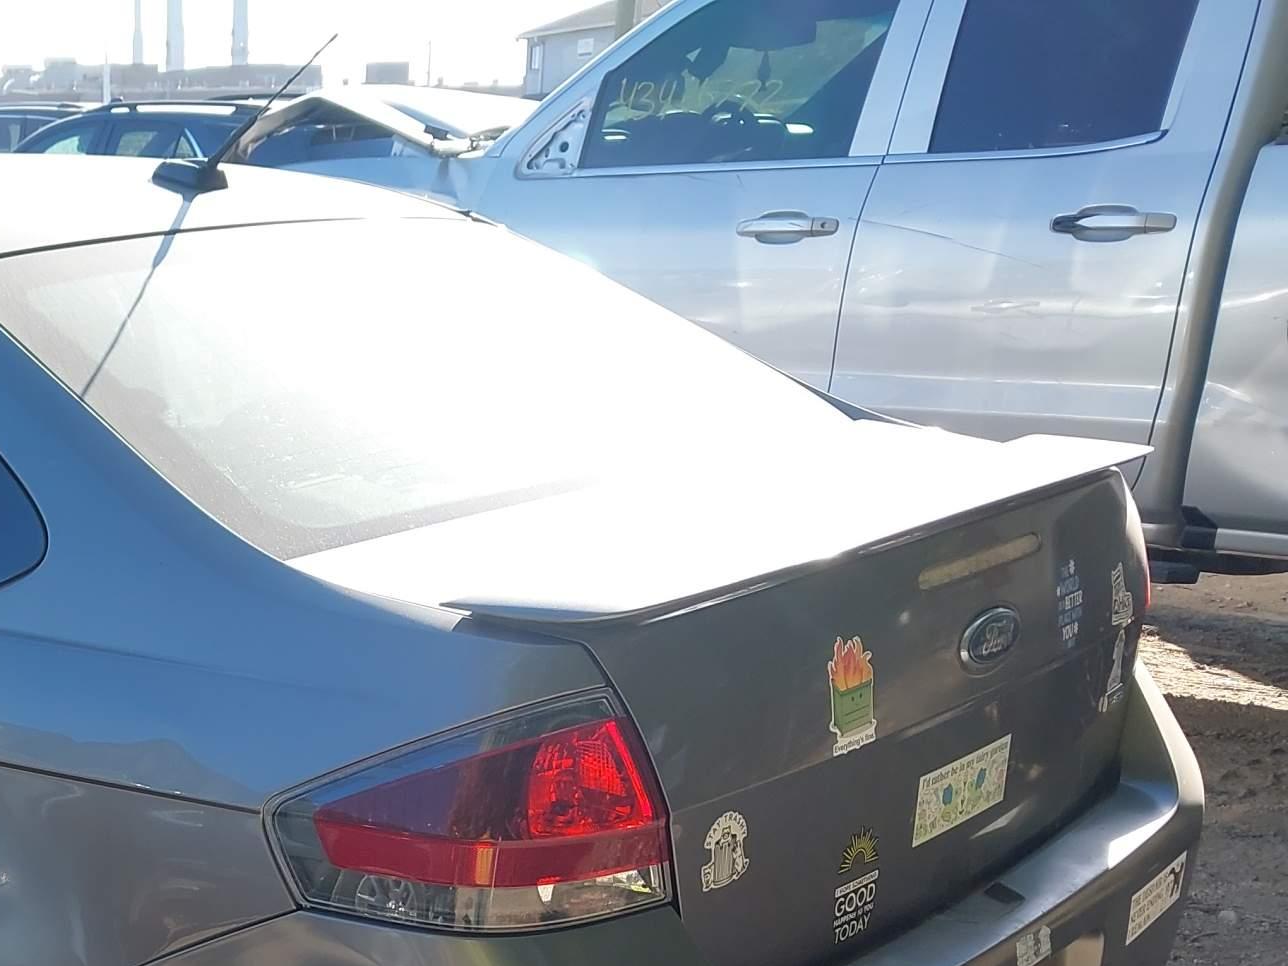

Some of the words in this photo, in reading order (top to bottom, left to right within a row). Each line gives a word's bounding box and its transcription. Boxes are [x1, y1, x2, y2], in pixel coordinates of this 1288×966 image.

[1065, 590, 1083, 610] BETTER
[835, 883, 876, 917] GOOD
[834, 912, 871, 944] TODAY
